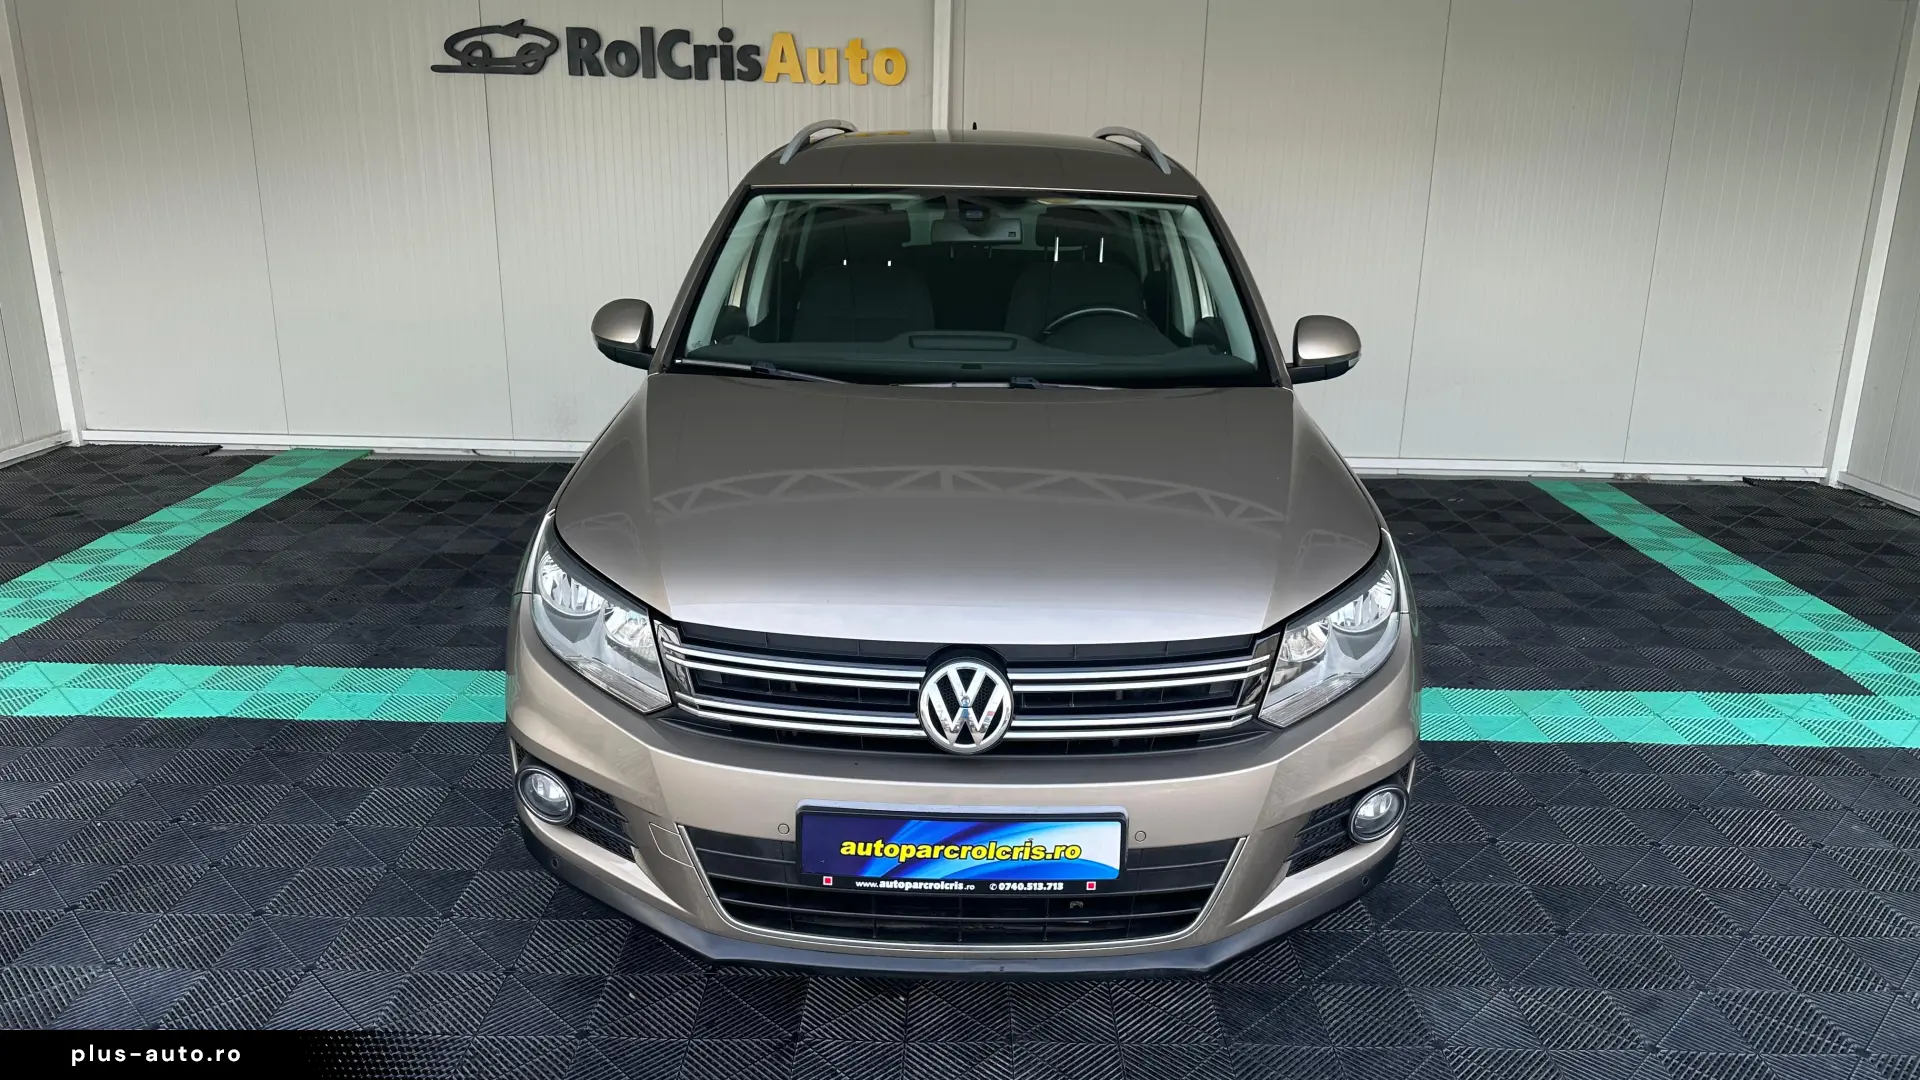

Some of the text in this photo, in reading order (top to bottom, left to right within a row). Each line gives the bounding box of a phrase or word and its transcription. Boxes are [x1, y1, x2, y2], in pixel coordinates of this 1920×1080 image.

[922, 663, 1010, 751] VW
[839, 838, 1082, 862] autoparcrolcris.ro
[855, 880, 975, 891] www.autoparcrolcris.ro
